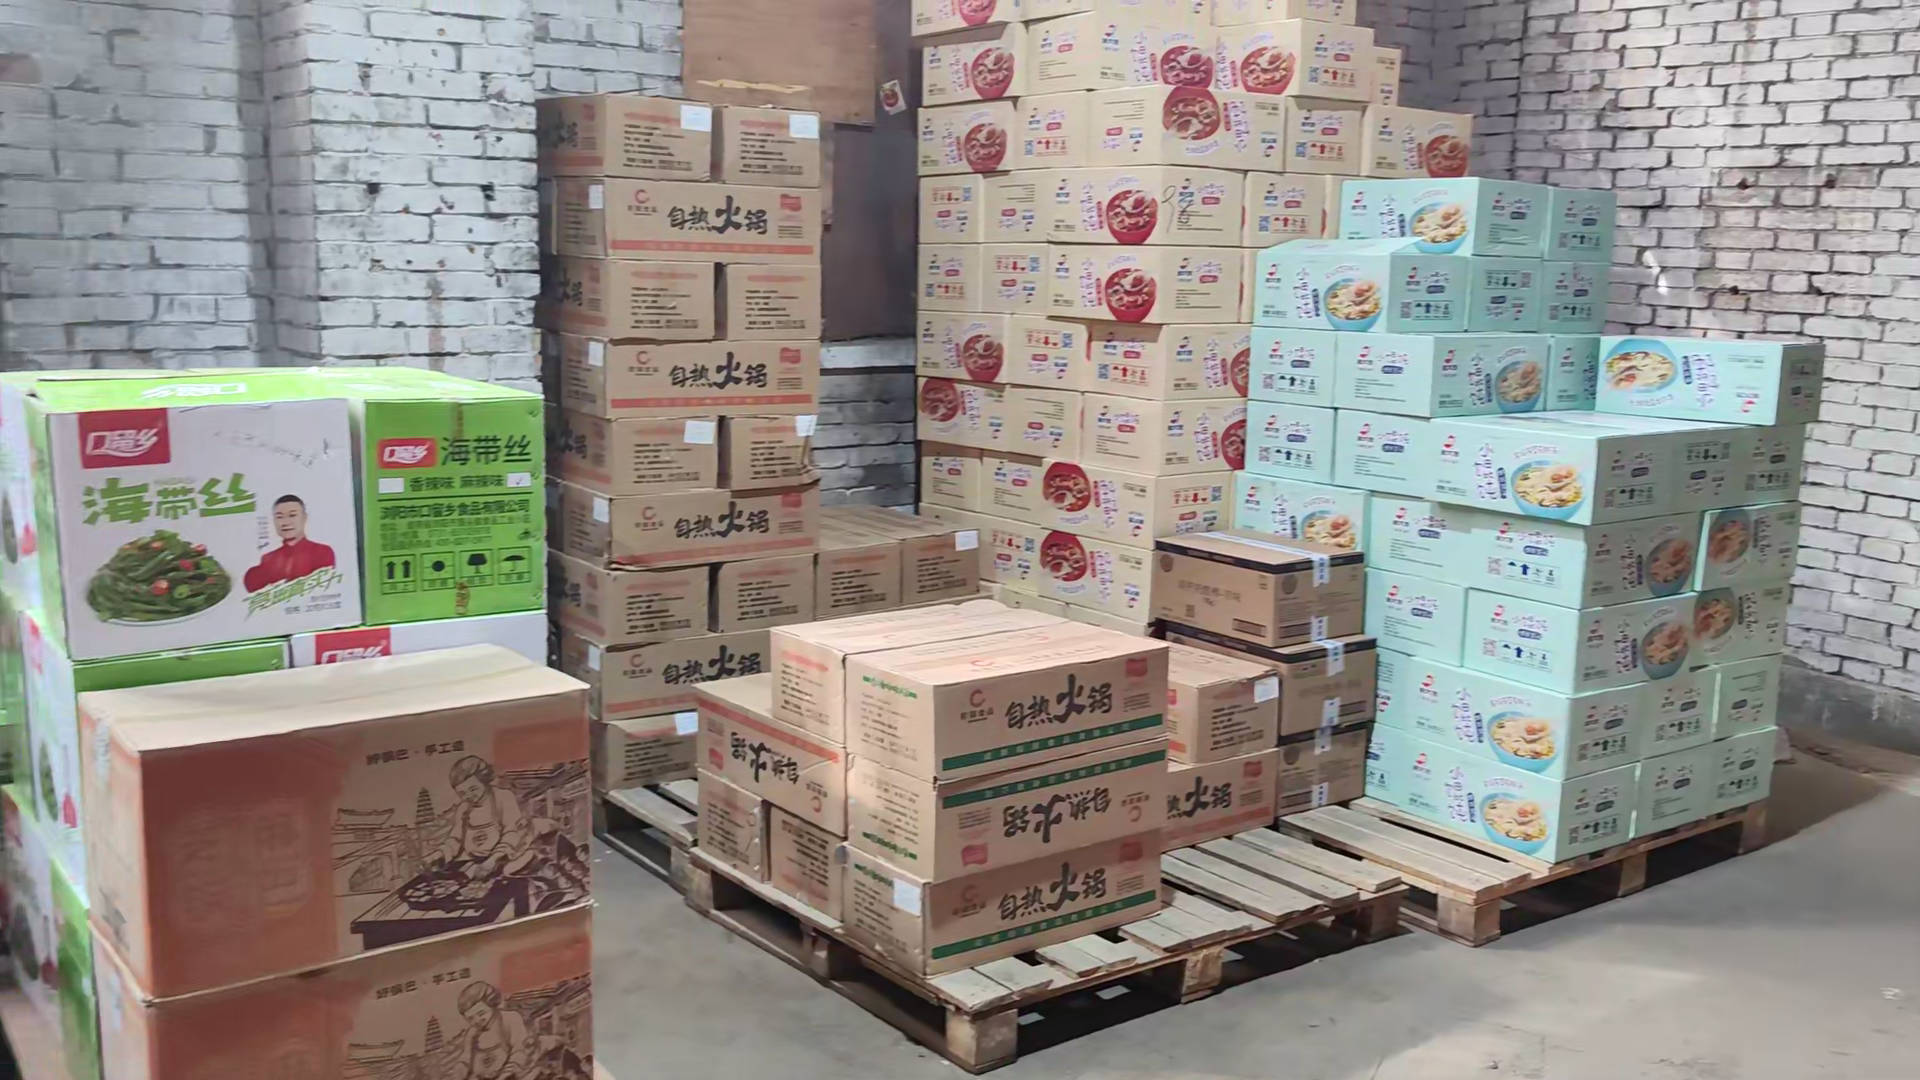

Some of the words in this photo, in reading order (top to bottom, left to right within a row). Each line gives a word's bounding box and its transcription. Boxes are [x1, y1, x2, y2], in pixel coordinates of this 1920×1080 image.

[667, 195, 767, 234] 自热火锅
[668, 352, 768, 389] 自热火锅
[440, 435, 532, 465] 海带丝
[82, 473, 255, 525] 海带丝
[674, 501, 770, 538] 自热火锅
[662, 644, 762, 684] 自热火锅
[1004, 673, 1112, 729] 自热火锅
[1003, 787, 1112, 843] 自热火锅
[997, 862, 1107, 921] 自热火锅
